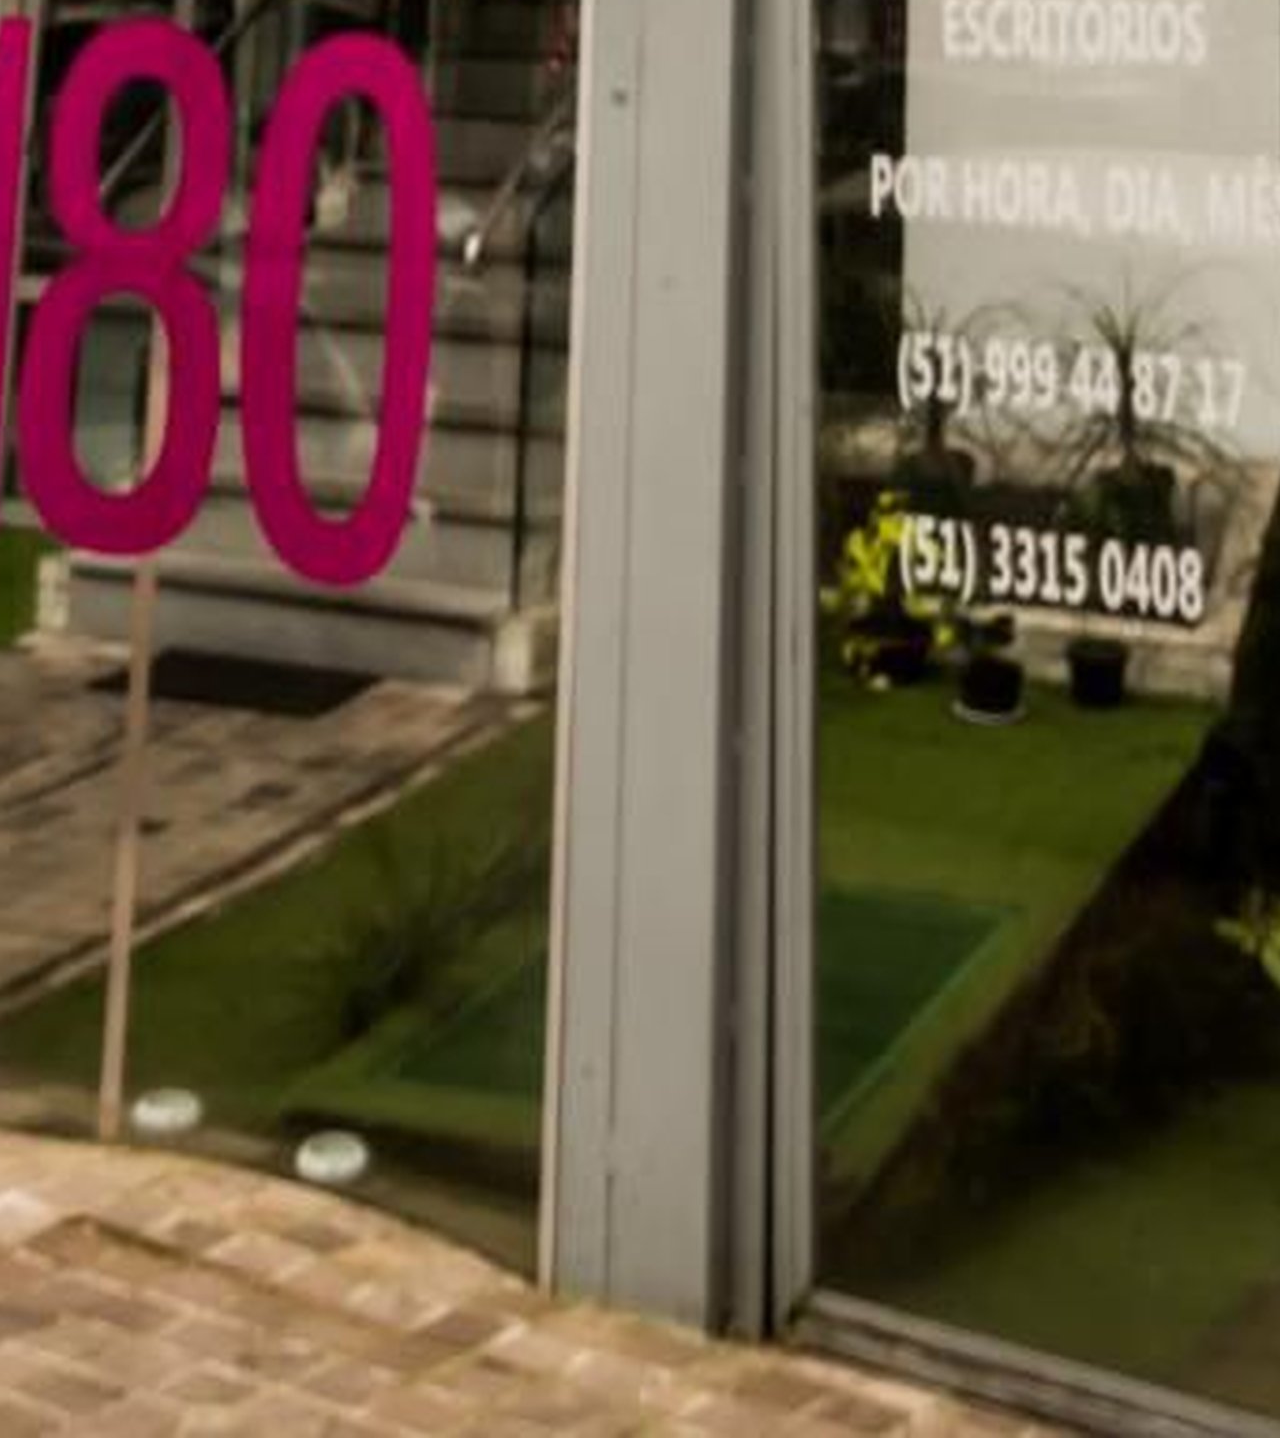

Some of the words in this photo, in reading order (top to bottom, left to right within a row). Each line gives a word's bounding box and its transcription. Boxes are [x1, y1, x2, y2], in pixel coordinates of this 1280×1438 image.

[871, 154, 952, 221] POR
[963, 158, 1092, 236] HORA,
[898, 332, 972, 415] (51)
[985, 338, 1057, 409] 999
[1132, 353, 1182, 421] 87
[1193, 357, 1246, 427] 17
[898, 513, 977, 605] (51)
[989, 525, 1087, 604] 3315
[1099, 539, 1203, 621] 0408
